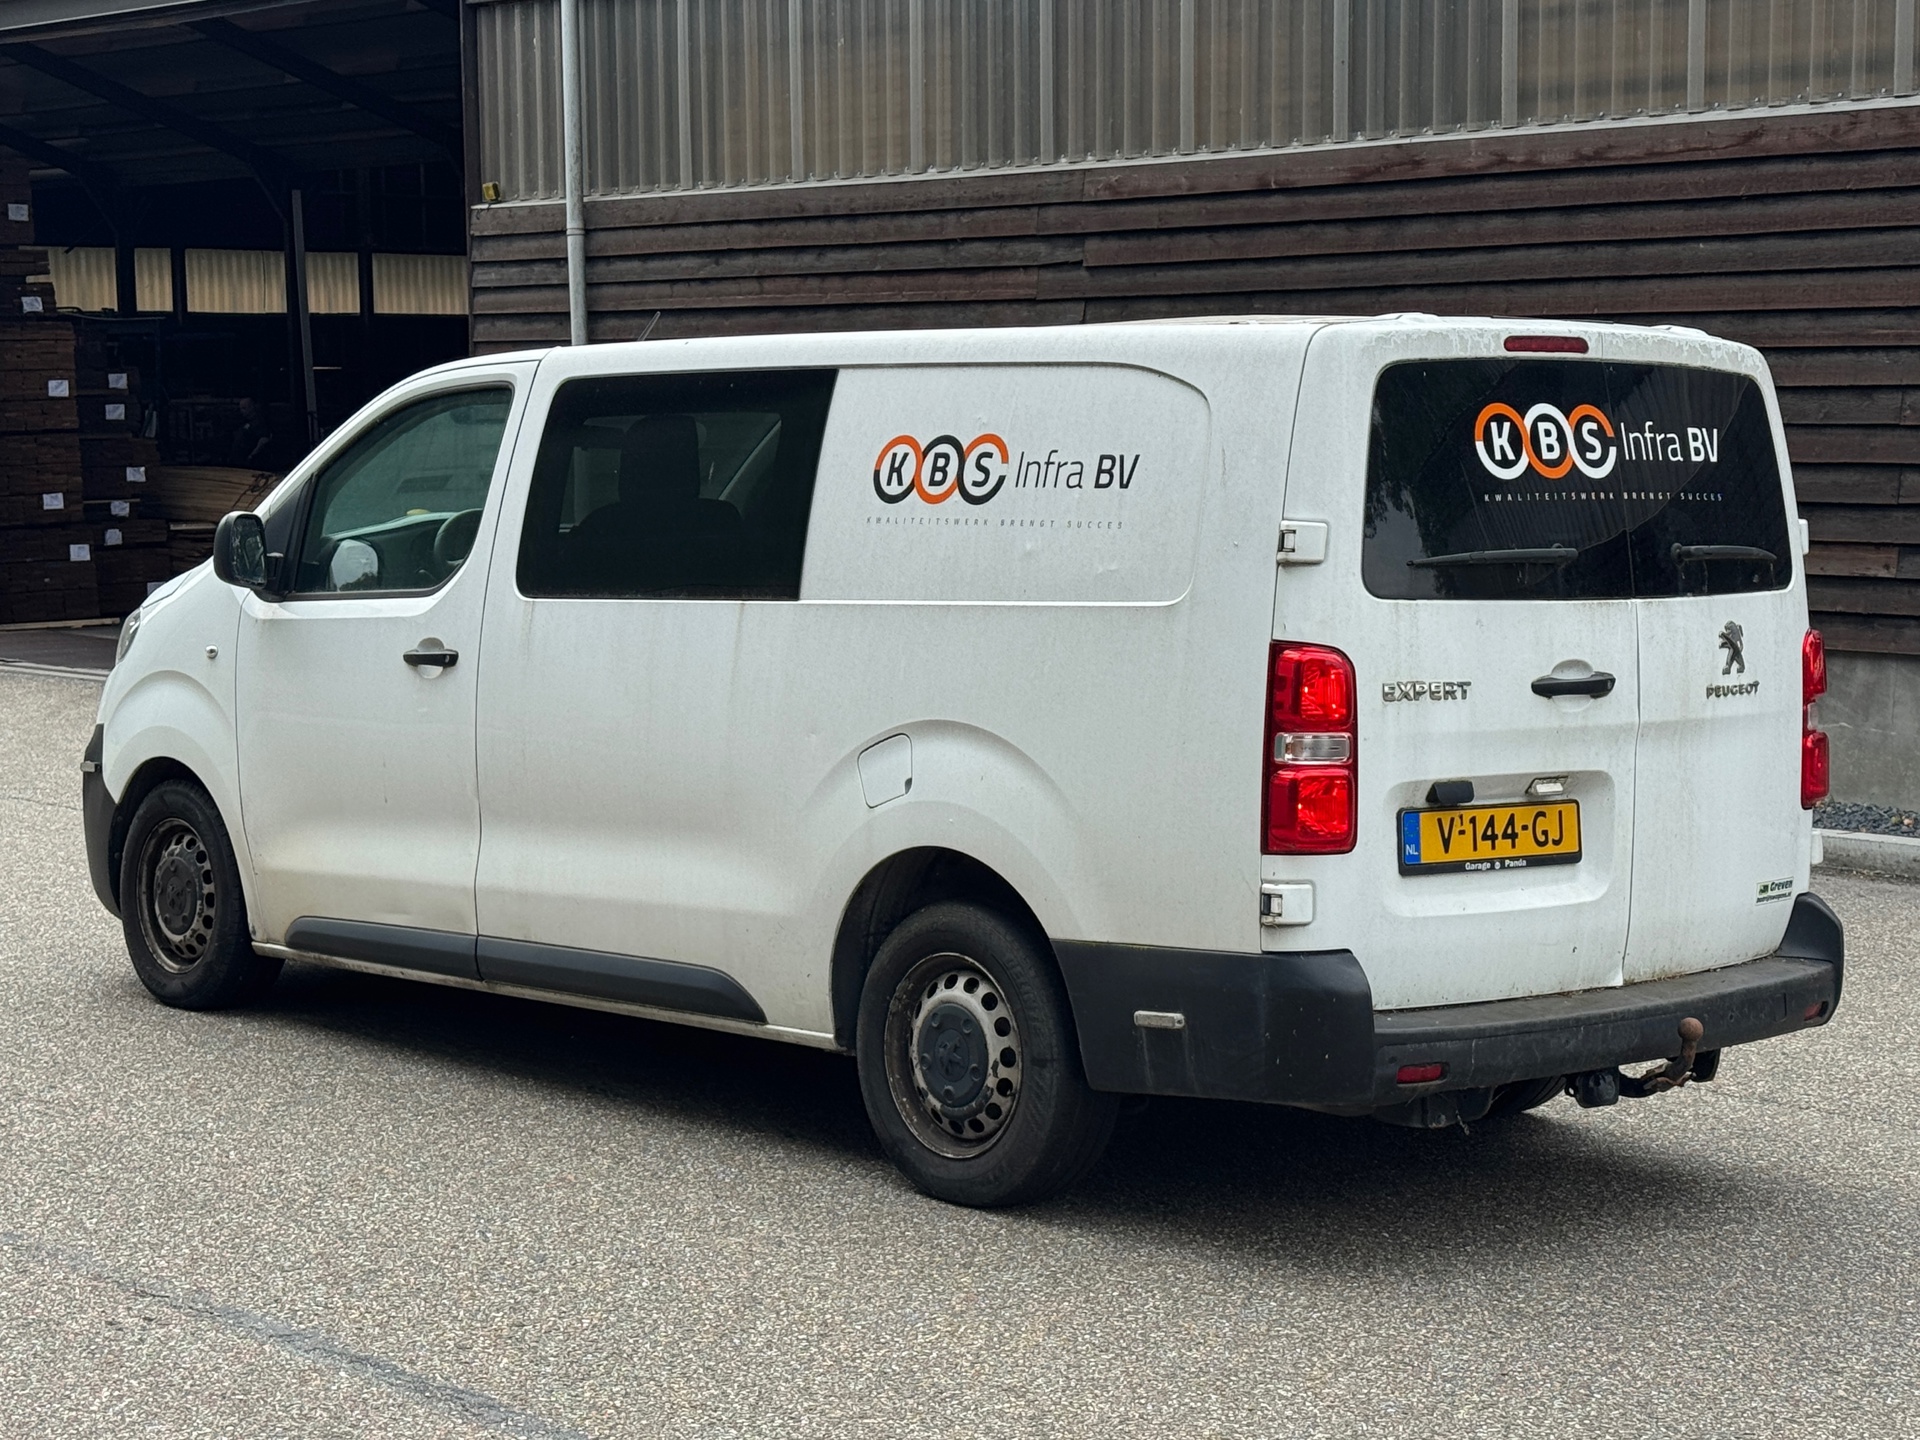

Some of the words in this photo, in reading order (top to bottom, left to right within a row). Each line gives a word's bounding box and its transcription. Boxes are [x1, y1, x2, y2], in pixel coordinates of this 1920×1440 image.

[1490, 421, 1602, 461] KBS
[1620, 421, 1684, 462] Infra
[1686, 426, 1718, 463] BV
[886, 451, 994, 488] KBS
[1015, 449, 1085, 490] Infra
[1093, 454, 1141, 490] BV
[1484, 492, 1615, 502] KWALITEITSWERK
[1623, 491, 1671, 501] BRENGT
[1680, 492, 1723, 502] SUCCES
[866, 516, 988, 527] KWALITEITSWERK
[1000, 518, 1055, 528] BRENGT
[1066, 520, 1123, 530] SUCCES
[1382, 681, 1472, 702] EXPERT
[1706, 680, 1760, 699] PEUGEOT
[1405, 844, 1419, 855] NL
[1465, 862, 1491, 871] Garage
[1504, 858, 1527, 868] Panda
[1770, 880, 1793, 892] Greven
